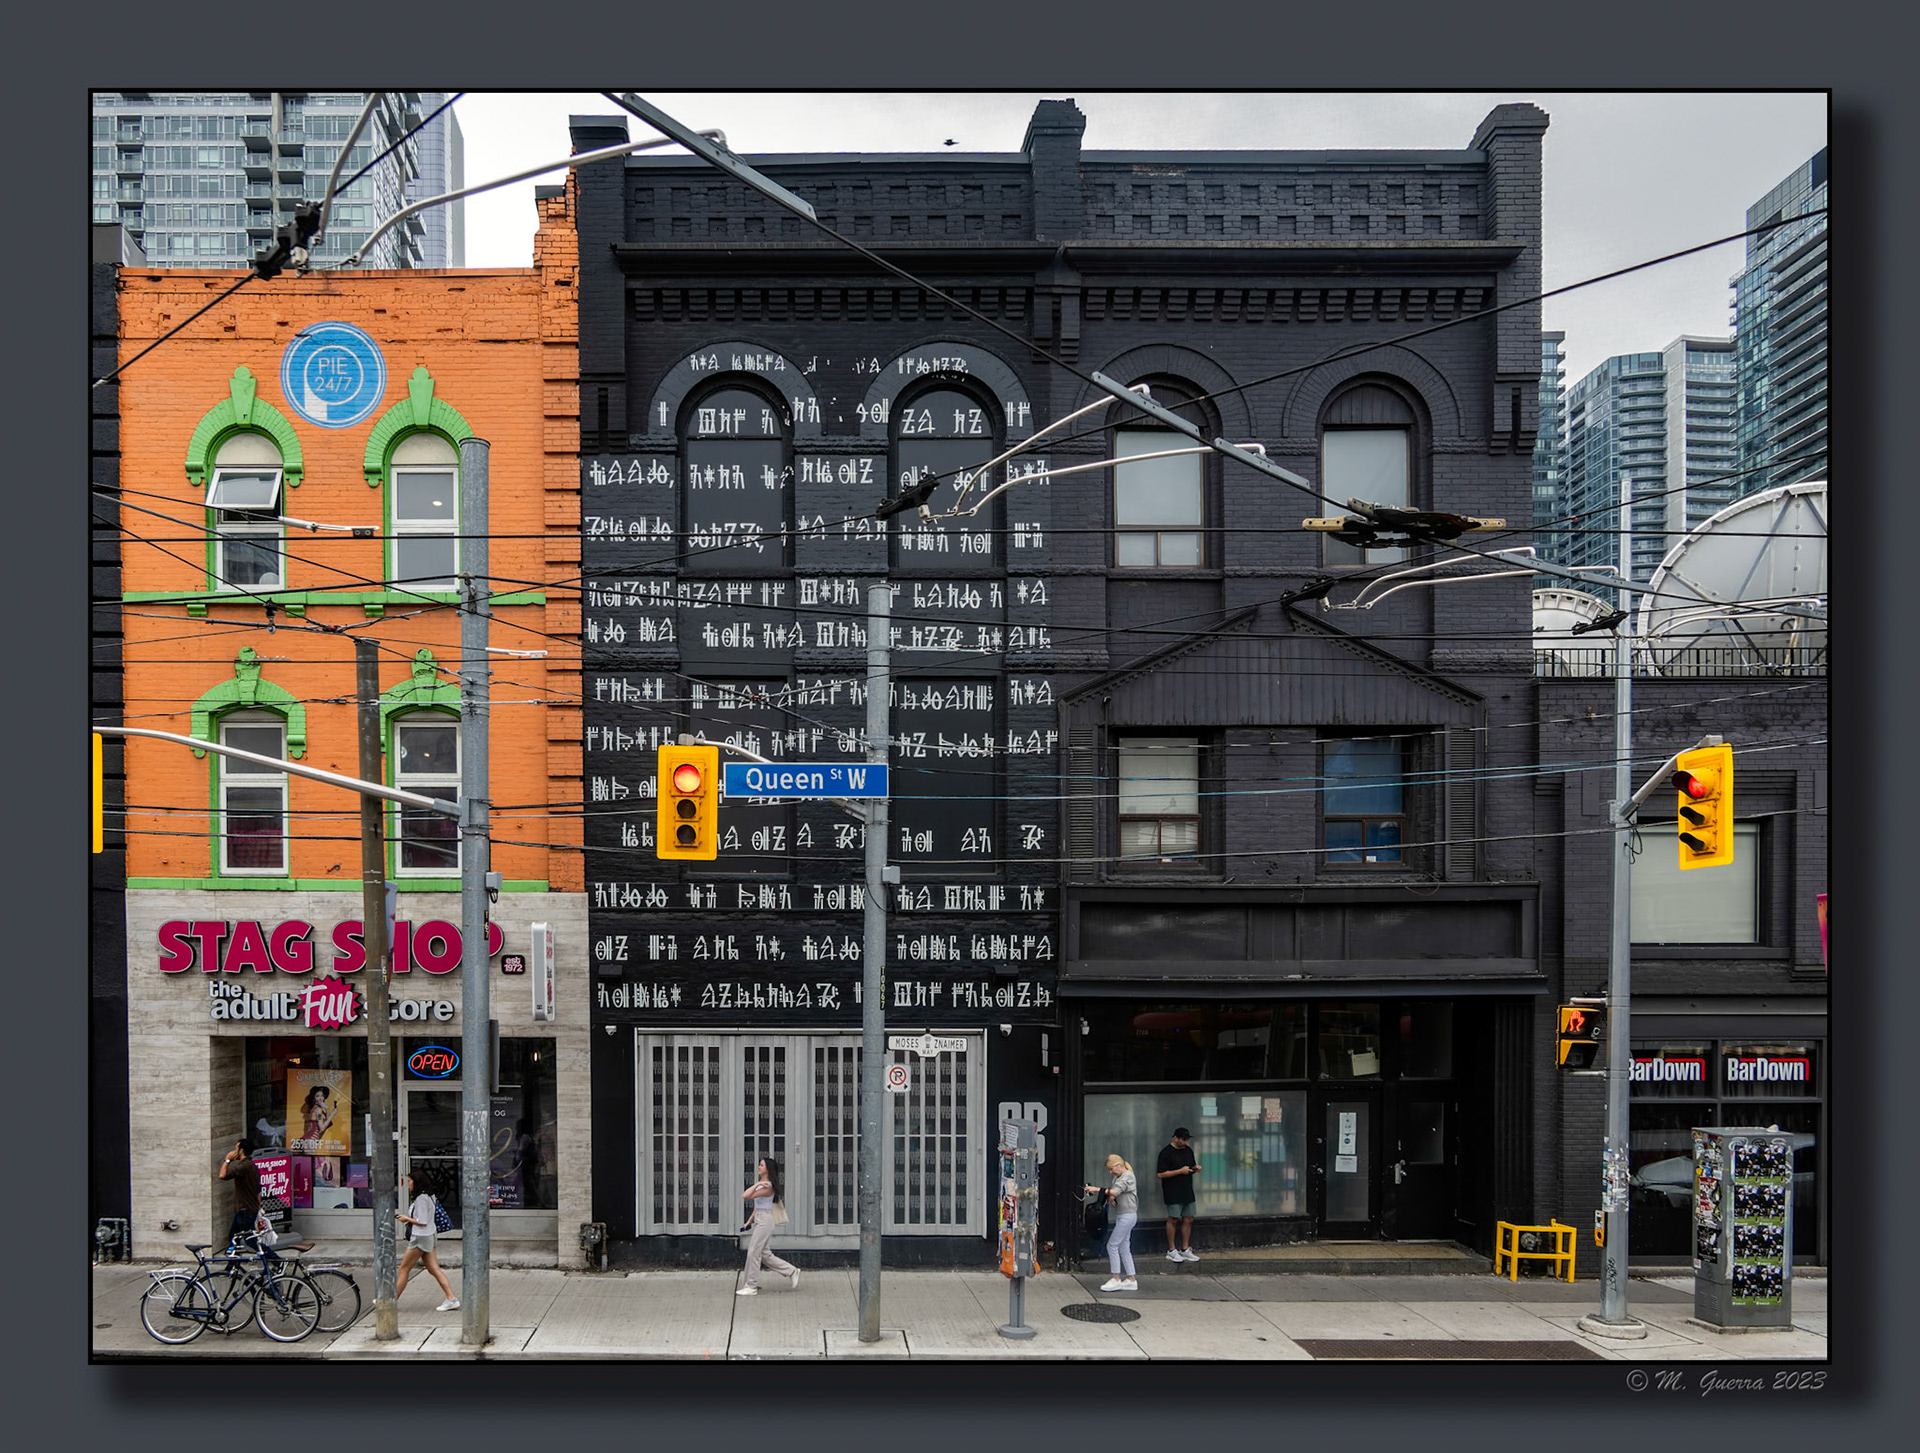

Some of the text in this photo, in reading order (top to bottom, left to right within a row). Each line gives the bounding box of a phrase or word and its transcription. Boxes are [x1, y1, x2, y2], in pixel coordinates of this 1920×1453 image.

[318, 357, 349, 375] PIE
[315, 376, 353, 393] 24/7
[746, 767, 867, 792] Queen St W
[157, 919, 314, 975] STAG
[504, 963, 523, 972] 1972
[505, 956, 521, 964] est
[208, 980, 242, 998] the
[210, 992, 297, 1021] adult
[301, 984, 359, 1029] Fun
[895, 1038, 964, 1050] MOSES ZNAIMER
[410, 1054, 455, 1070] OPEN
[1727, 1057, 1804, 1081] BarDown
[290, 1138, 308, 1150] 25%
[309, 1138, 324, 1150] OFF
